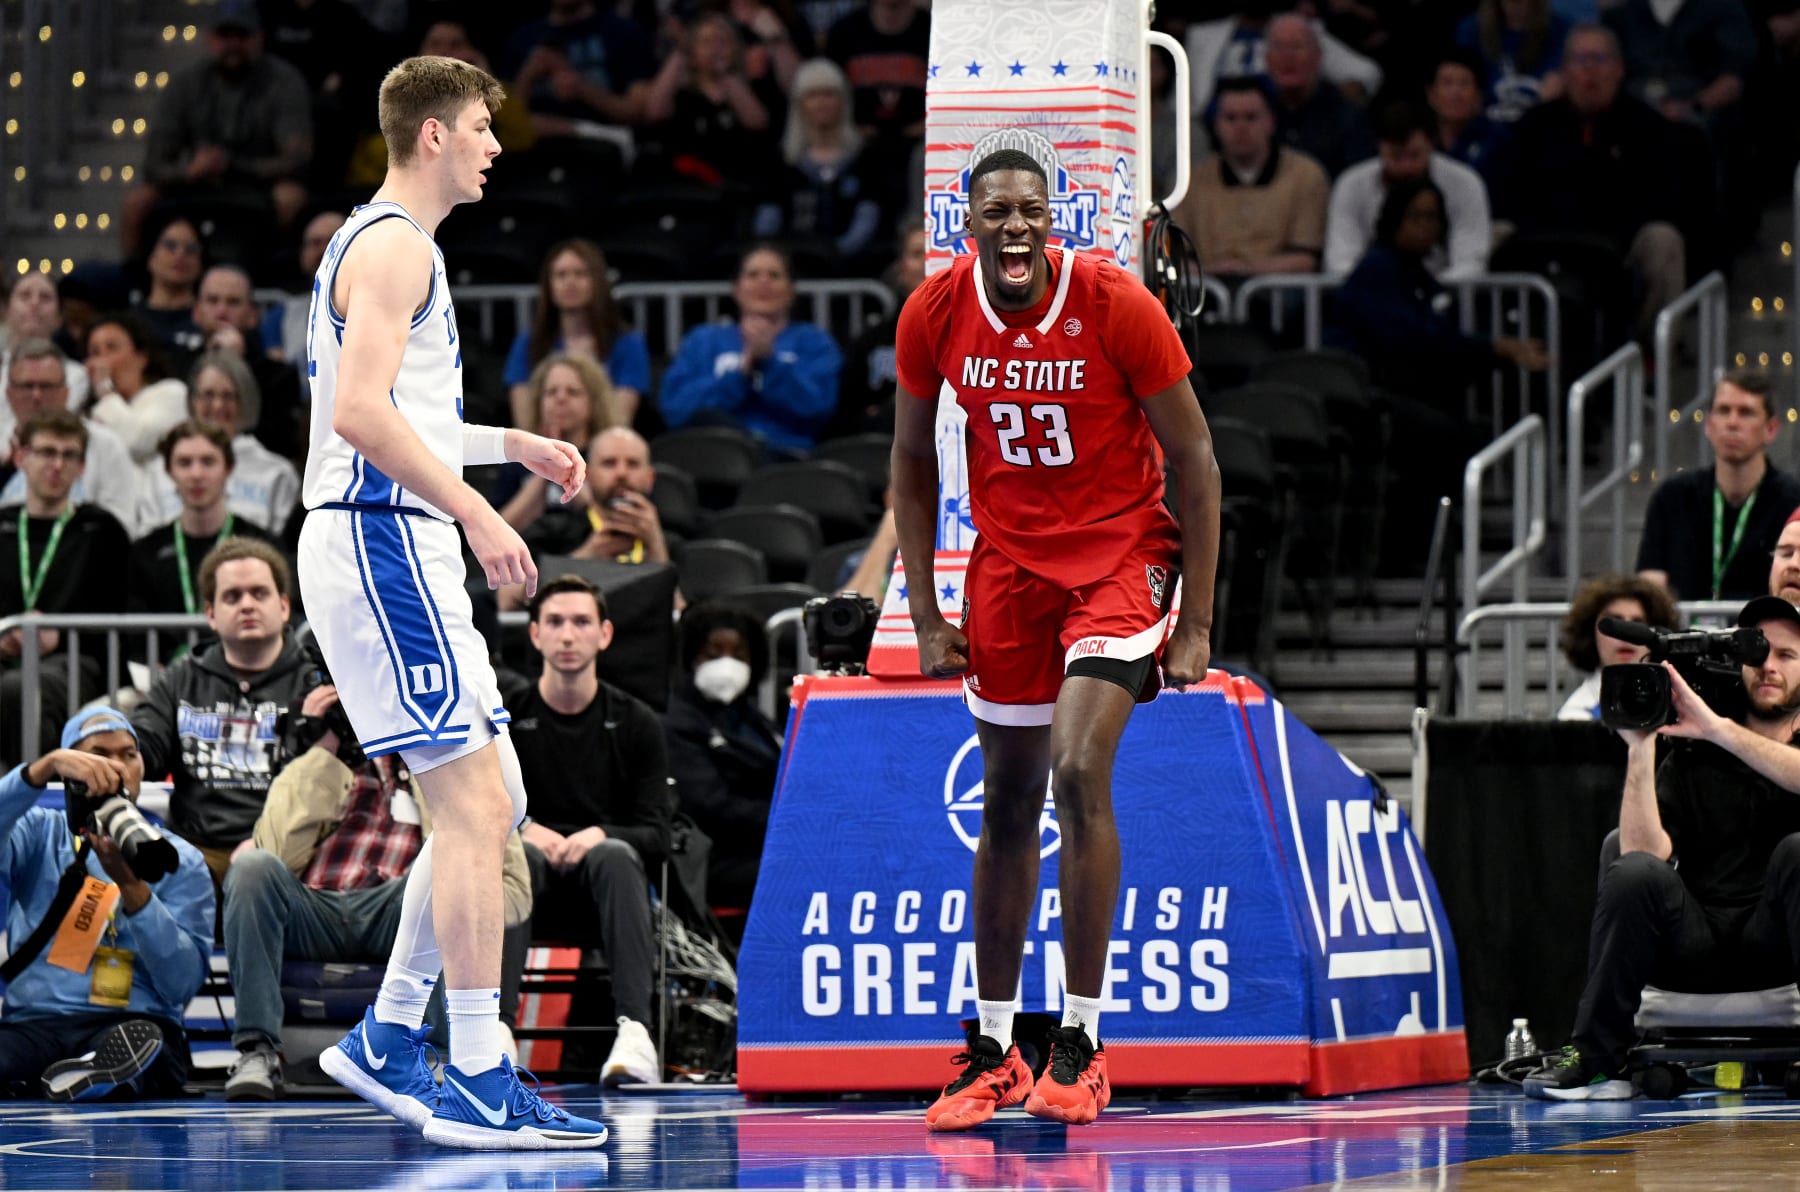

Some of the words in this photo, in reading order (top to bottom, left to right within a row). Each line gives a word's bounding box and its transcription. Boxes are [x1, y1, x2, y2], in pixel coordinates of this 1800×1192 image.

[1114, 193, 1132, 219] ACC
[961, 356, 1000, 389] NC
[1003, 359, 1087, 391] STATE
[988, 402, 1076, 467] 23
[1073, 639, 1108, 657] PACK
[408, 663, 444, 695] D
[1326, 799, 1427, 938] ACC
[802, 886, 1229, 935] ACCOPISH
